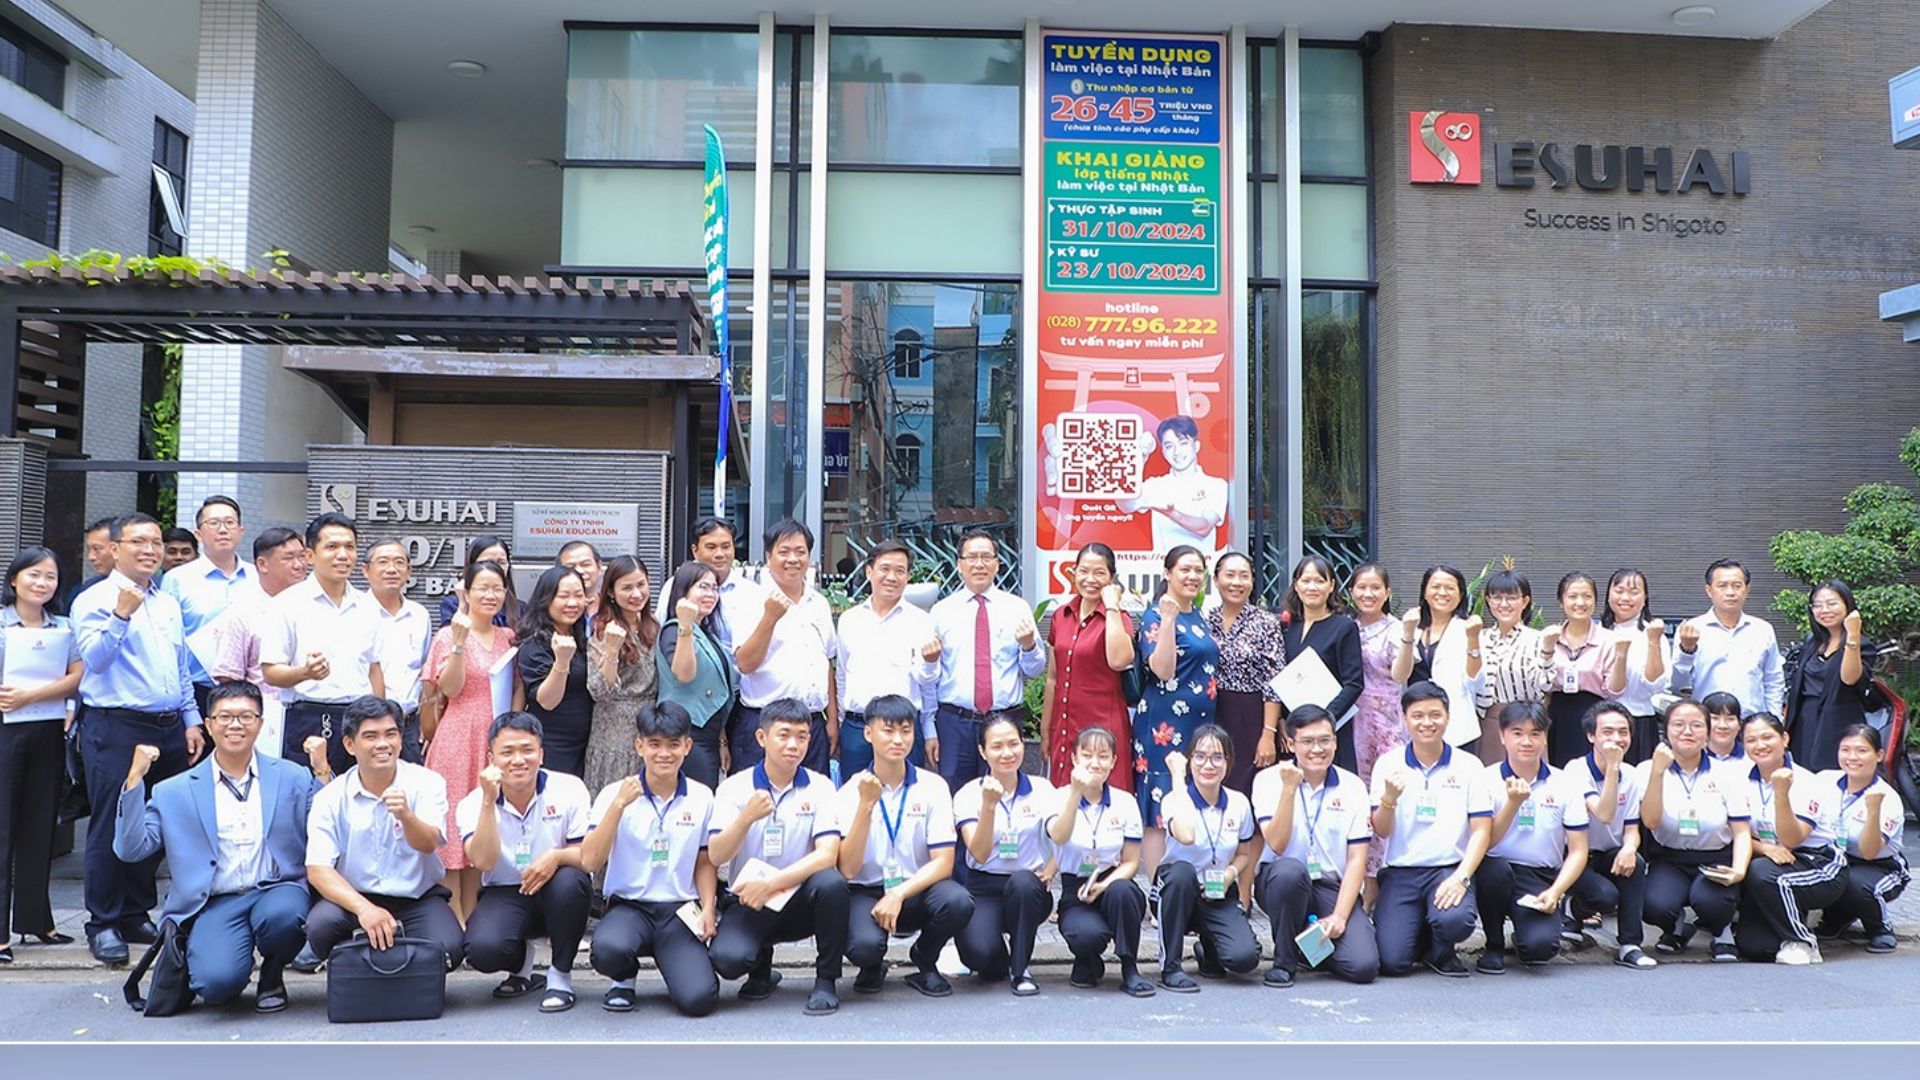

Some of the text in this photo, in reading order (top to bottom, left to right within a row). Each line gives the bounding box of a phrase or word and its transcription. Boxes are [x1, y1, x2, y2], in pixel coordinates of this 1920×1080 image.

[1051, 40, 1212, 66] TUYỂN DỤNG
[1051, 62, 1212, 79] làm việc tại Nhật Bản
[1086, 83, 1108, 92] Thu
[1110, 84, 1139, 95] nhập
[1157, 85, 1179, 94] bản
[1159, 101, 1189, 112] TRIỆU
[1172, 114, 1200, 123] tháng
[1057, 150, 1206, 170] KHAI GIẢNG
[1494, 141, 1750, 195] ESUHAI
[1074, 168, 1190, 184] lớp tiếng Nhật
[1057, 180, 1206, 195] làm việc tại Nhật Bản
[1058, 203, 1163, 217] THỰC TẬP SINH
[1062, 219, 1206, 241] 31/10/2024
[1524, 208, 1728, 239] Success in Shigoto
[1057, 246, 1100, 258] KỸ SƯ
[1057, 261, 1206, 281] 23/10/2024
[1105, 302, 1160, 314] hotline
[1046, 315, 1218, 335] (028) 777.96.222
[1060, 335, 1205, 350] tư vấn ngay miễn phí
[367, 498, 498, 524] ESUHAI
[544, 517, 569, 526] CÔNG
[529, 527, 619, 536] ESUHAI EDUCATION
